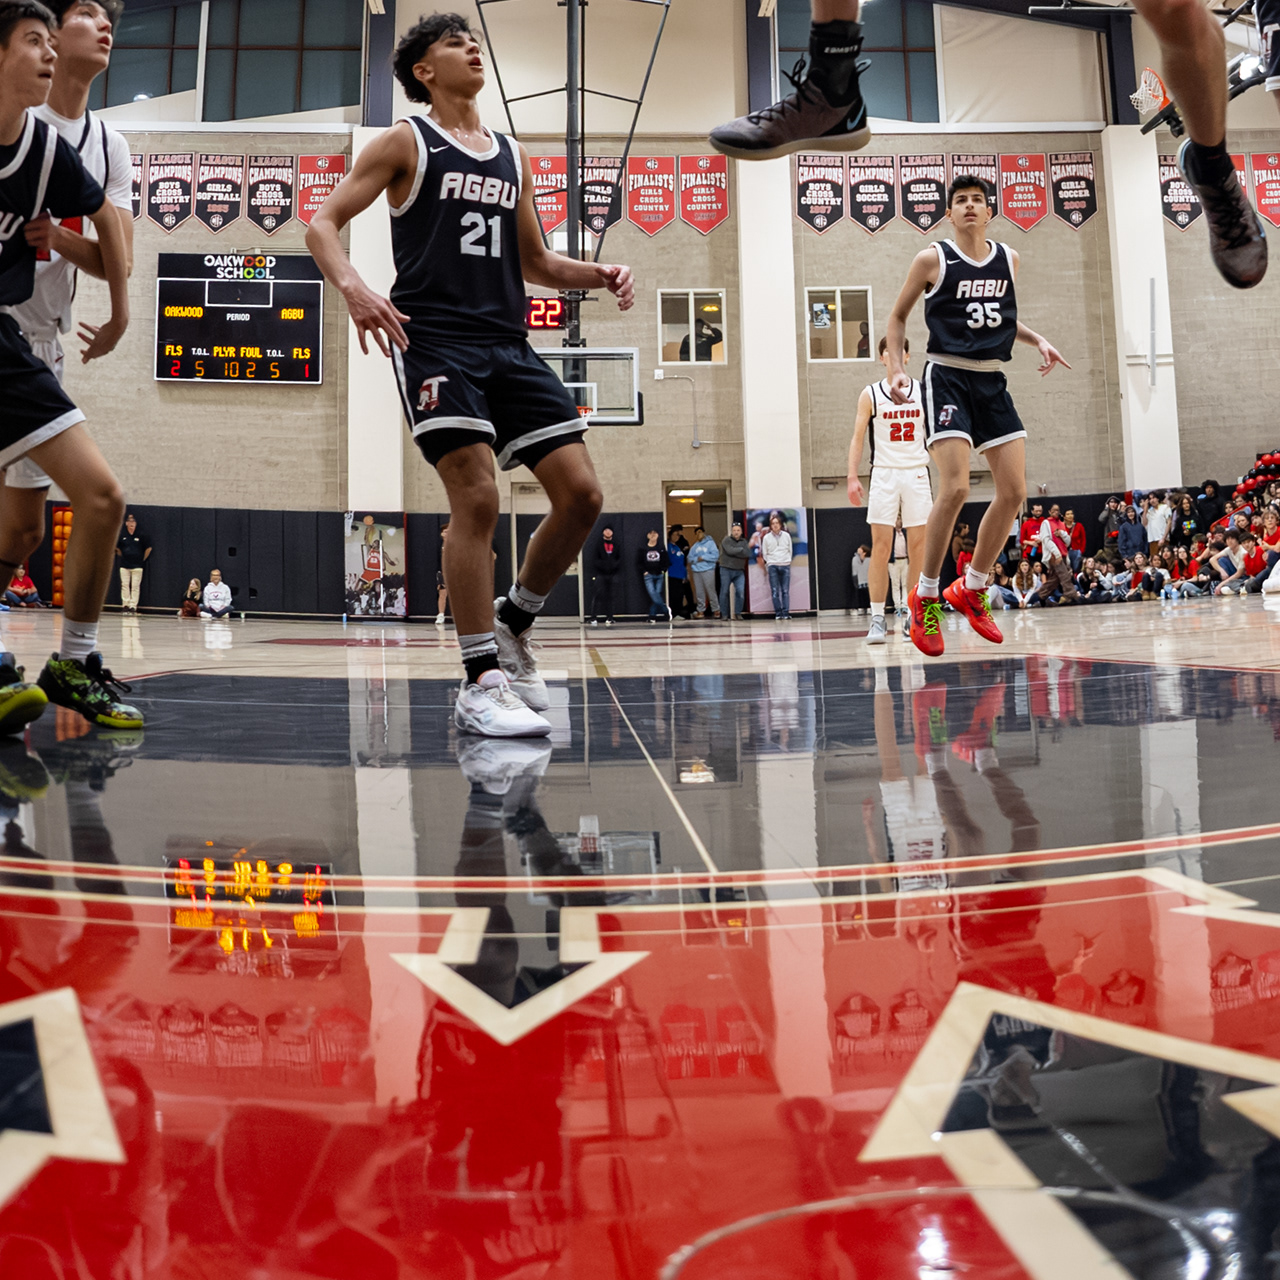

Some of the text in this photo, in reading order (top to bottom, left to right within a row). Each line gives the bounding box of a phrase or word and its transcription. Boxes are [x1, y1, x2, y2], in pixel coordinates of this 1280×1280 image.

[149, 166, 192, 184] CHAMPIONS
[199, 167, 242, 184] CHAMPIONS
[249, 168, 293, 185] CHAMPIONS
[681, 172, 726, 190] FINALISTS
[799, 167, 842, 186] CHAMPIONS
[850, 167, 894, 186] CHAMPIONS
[901, 166, 944, 185] CHAMPIONS
[1002, 171, 1045, 188] FINALISTS
[1052, 164, 1093, 183] CHAMPIONS
[207, 184, 232, 192] GIRLS
[439, 172, 516, 210] AGBU
[629, 174, 673, 191] FINALISTS
[1061, 181, 1086, 189] GIRLS
[151, 196, 190, 204] COUNTRY
[196, 192, 240, 201] SOFTBALL
[251, 198, 291, 206] COUNTRY
[801, 197, 842, 205] COUNTRY
[856, 194, 889, 202] SOCCER
[908, 192, 940, 201] SOCCER
[1059, 190, 1090, 198] SOCCER
[460, 211, 501, 257] 21
[204, 255, 276, 267] OAKWOOD
[217, 267, 274, 279] SCHOOL
[956, 280, 1008, 299] AGBU
[165, 306, 203, 318] OAKWOOD
[227, 313, 250, 321] PERIOD
[281, 308, 304, 319] AGBU
[530, 300, 561, 326] 22
[966, 302, 1002, 329] 35
[165, 345, 183, 356] FLS
[213, 346, 236, 357] PLYR
[240, 347, 262, 358] FOUL
[293, 348, 311, 359] FLS
[171, 360, 308, 378] 2 5 10 2 5 1
[883, 409, 920, 419] OAKWOOD
[890, 421, 914, 441] 22
